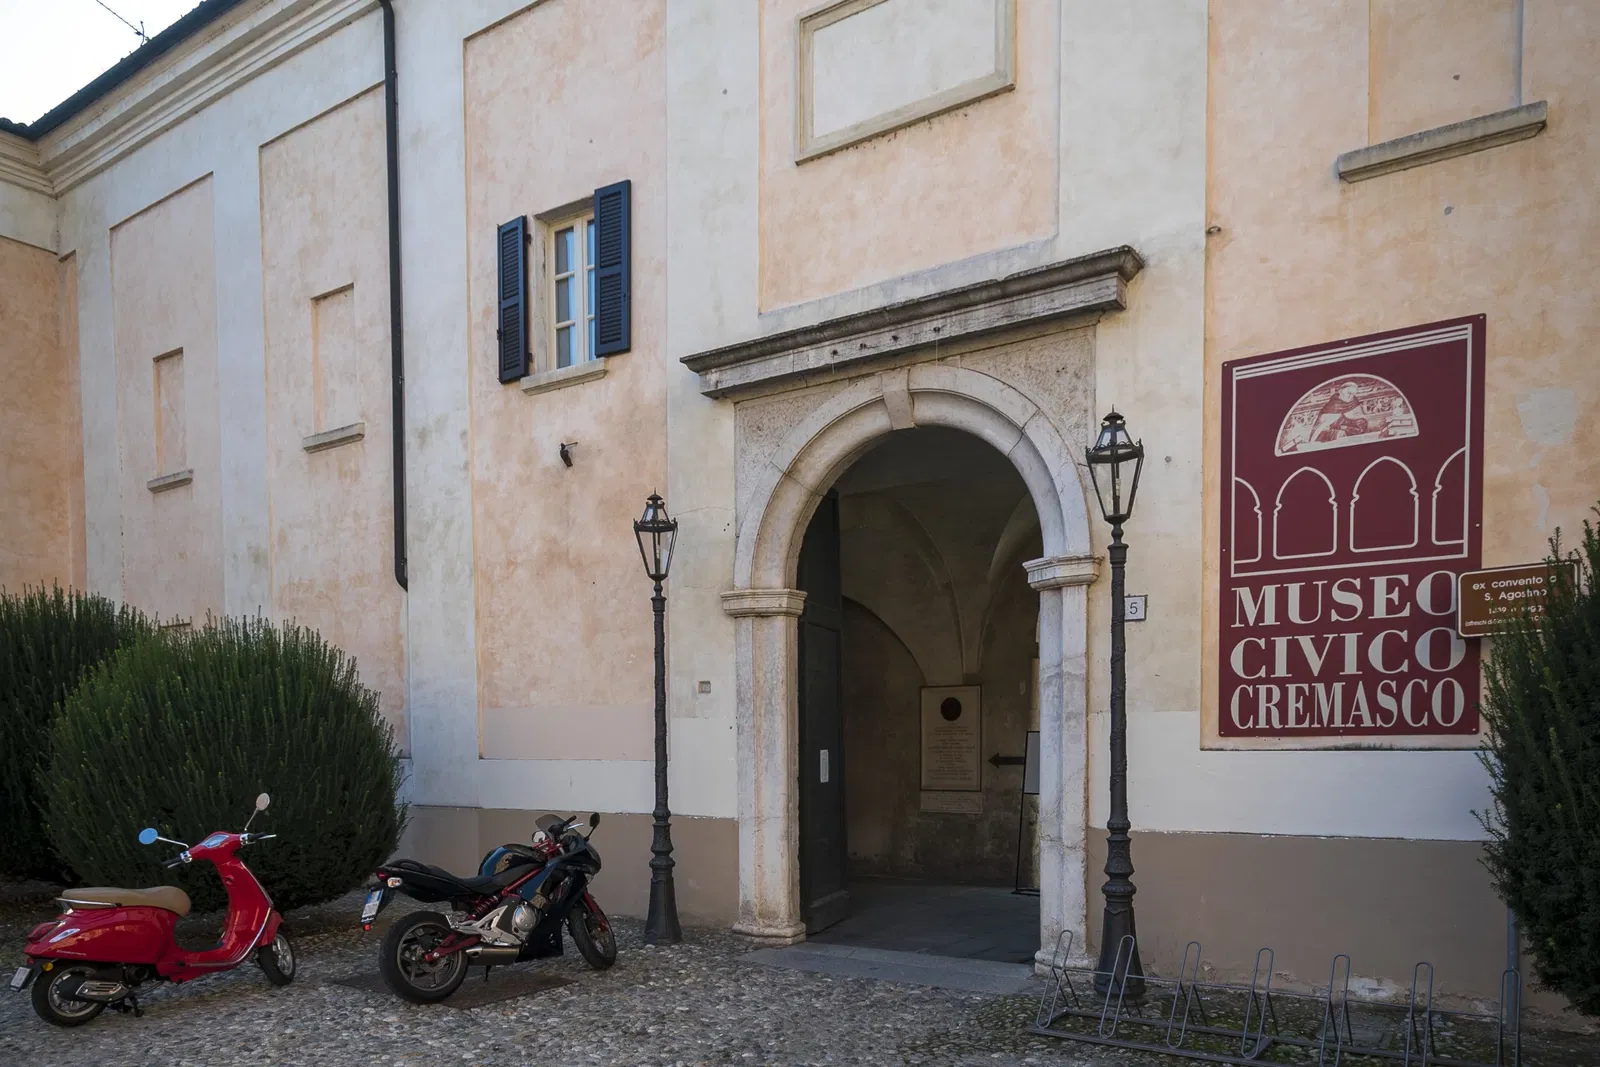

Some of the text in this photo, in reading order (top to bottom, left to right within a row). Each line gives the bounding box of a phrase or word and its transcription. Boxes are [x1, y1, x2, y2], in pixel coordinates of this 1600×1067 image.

[1231, 570, 1456, 627] MUSEO
[1472, 582, 1486, 591] ex
[1491, 575, 1543, 589] convento
[1484, 592, 1494, 602] S.
[1129, 601, 1138, 615] 5
[1230, 627, 1466, 679] CIVICO
[1230, 677, 1465, 730] CREMASCO
